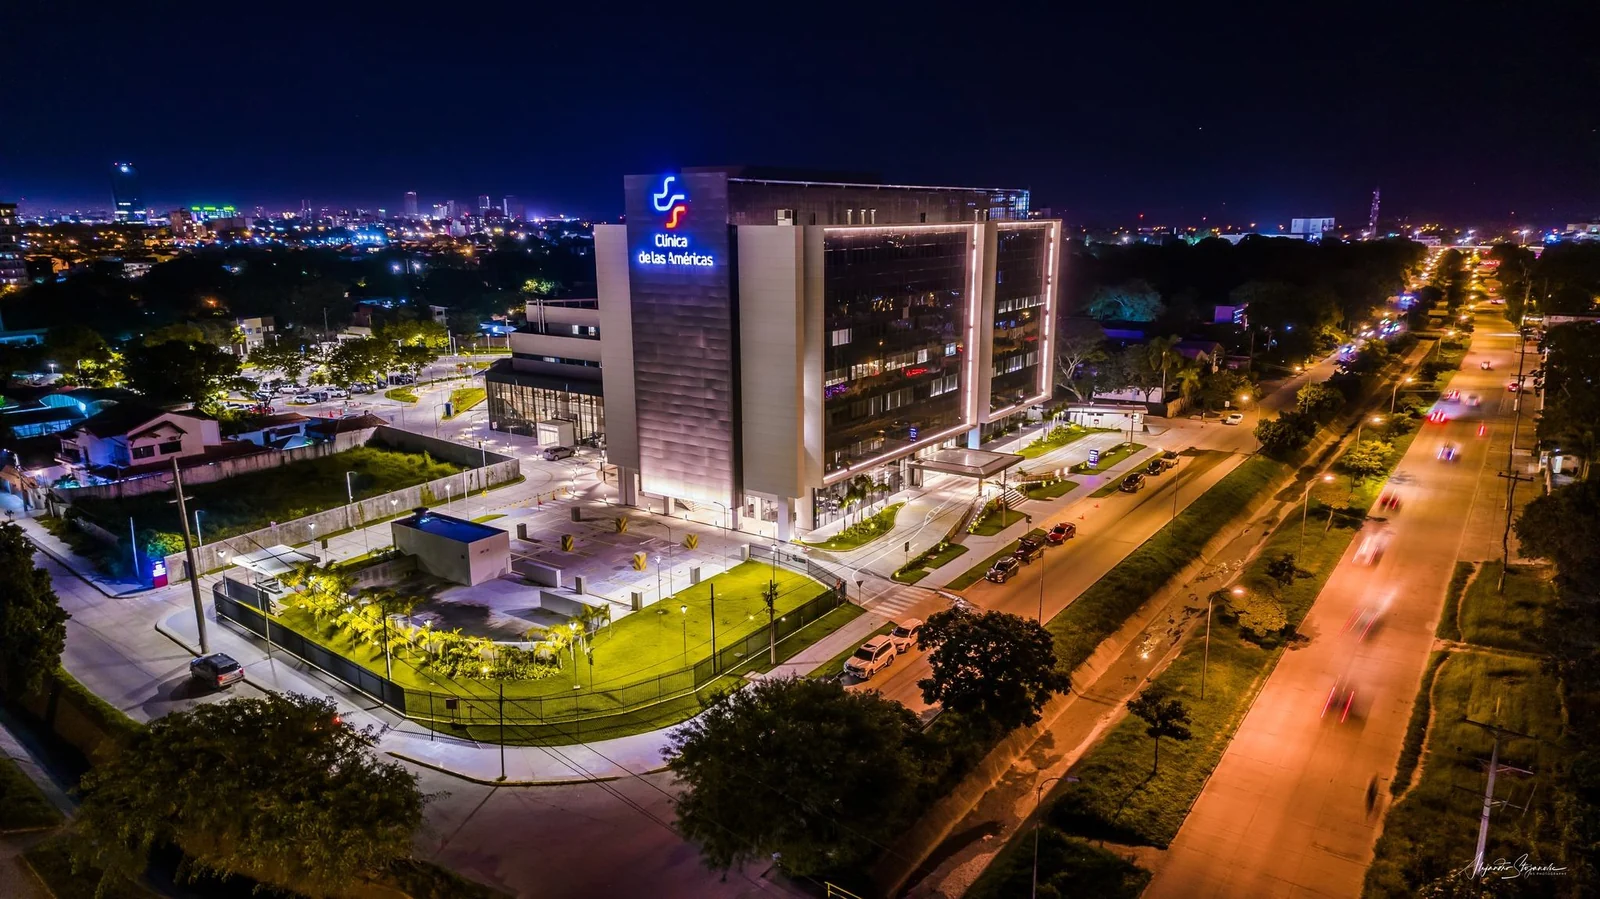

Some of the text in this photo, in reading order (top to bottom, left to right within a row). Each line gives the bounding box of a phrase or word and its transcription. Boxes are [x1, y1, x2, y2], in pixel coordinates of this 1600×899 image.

[655, 234, 688, 248] Clínica
[638, 251, 713, 266] de las Américas
